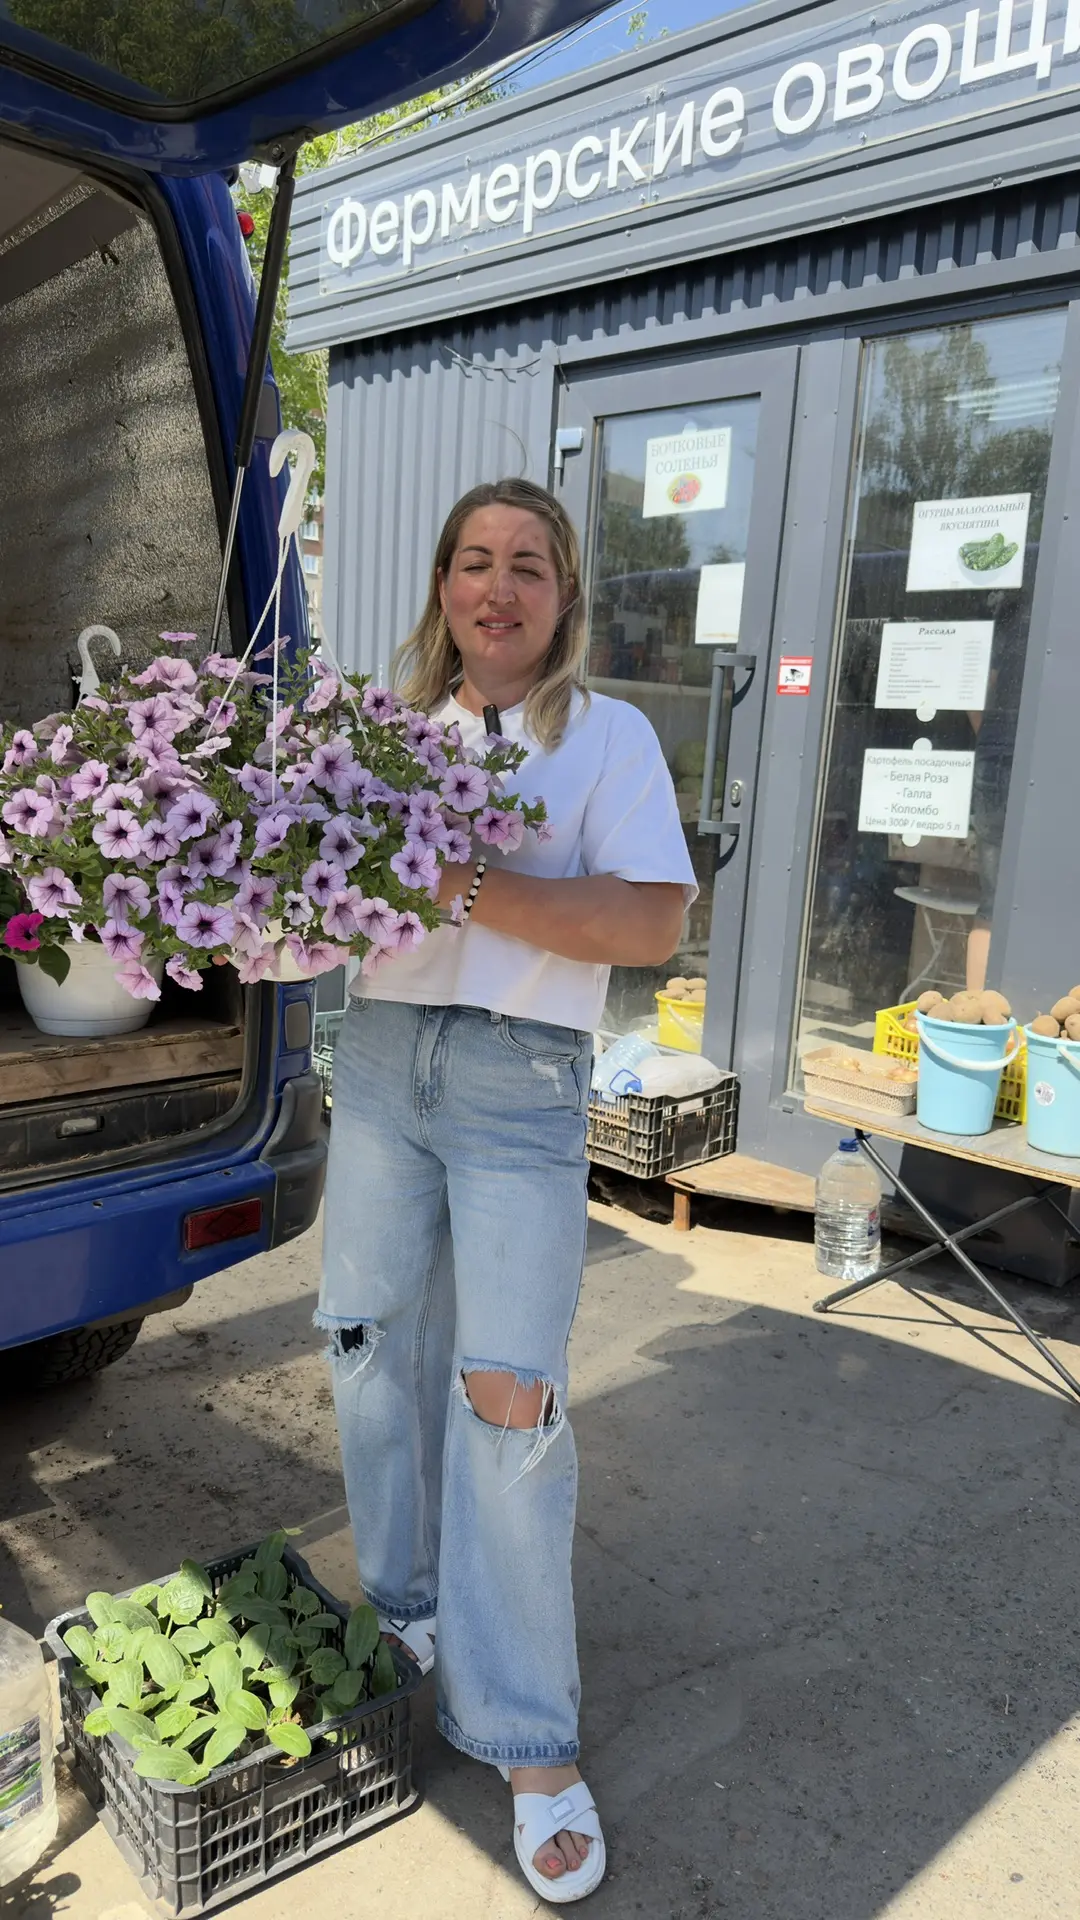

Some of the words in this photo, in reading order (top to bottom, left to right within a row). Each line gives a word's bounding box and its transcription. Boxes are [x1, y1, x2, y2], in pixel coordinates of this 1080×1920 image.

[326, 86, 745, 269] Фермерские
[651, 433, 726, 457] БОЧКОВЫЕ
[655, 454, 718, 475] СОЛЕНЬЯ
[918, 508, 954, 519] ОГУРЦЫ
[940, 519, 1000, 531] ВКУСНЯТИНА
[866, 756, 913, 767] Картофель
[914, 758, 972, 768] посадочный
[890, 771, 921, 782] Белая
[923, 772, 949, 783] Роза
[903, 788, 932, 799] Галла
[891, 803, 939, 816] Коломбо
[865, 816, 887, 826] Цена
[916, 821, 944, 832] ведро
[946, 821, 953, 831] 5
